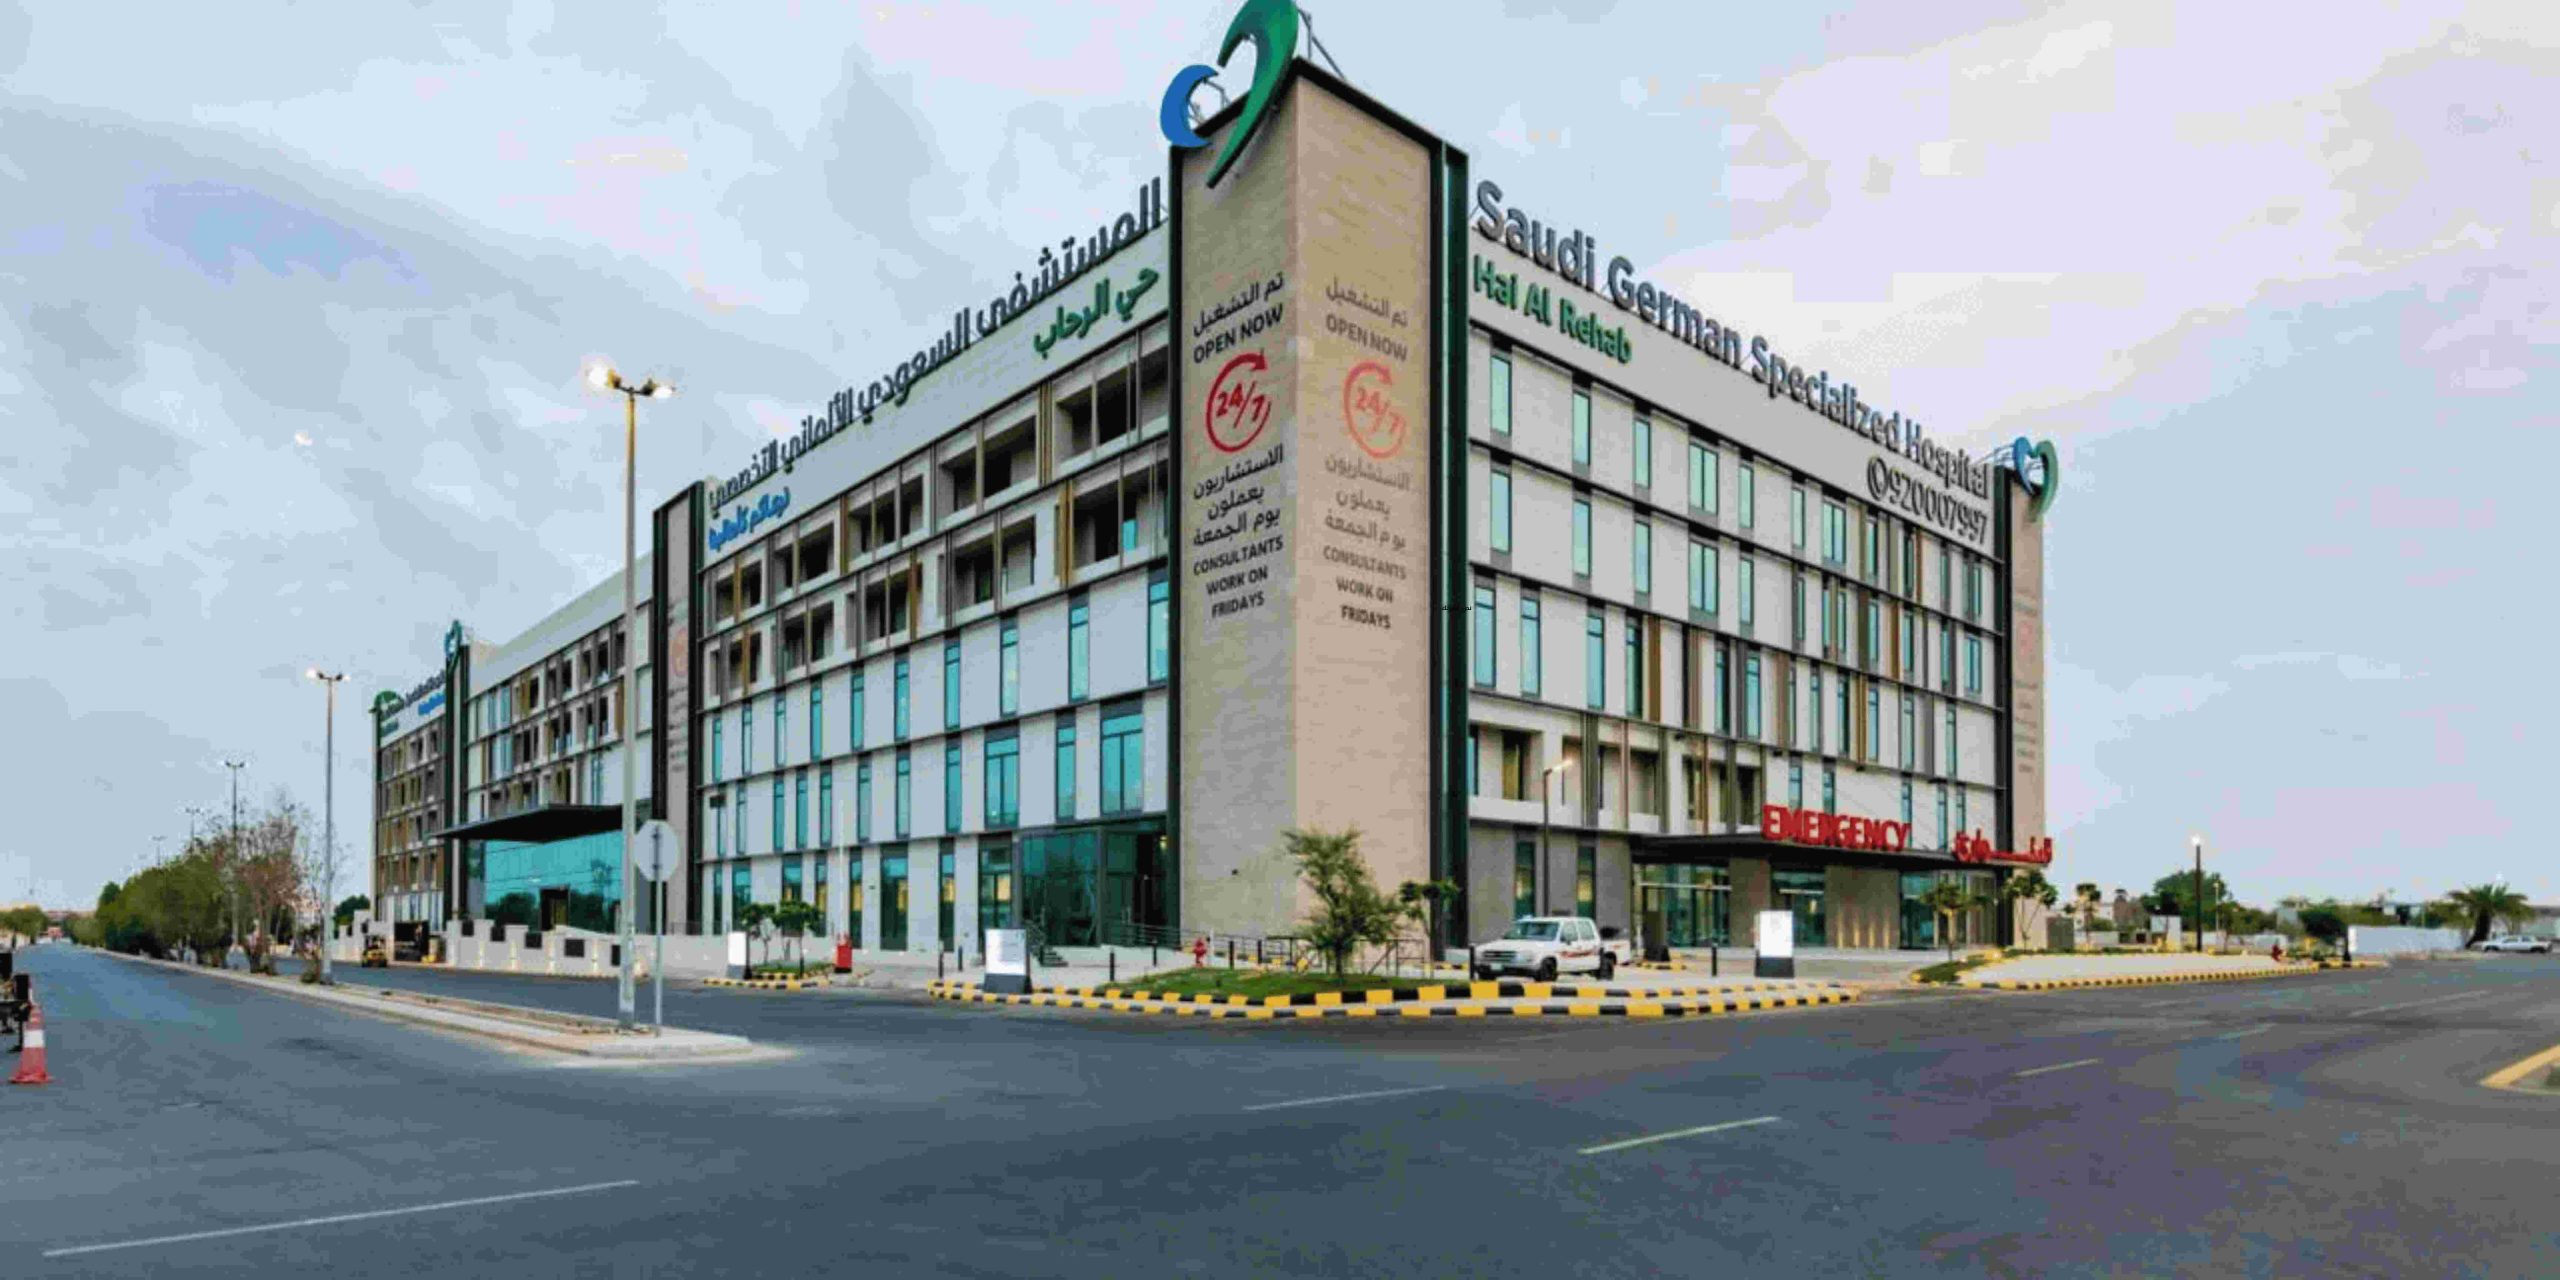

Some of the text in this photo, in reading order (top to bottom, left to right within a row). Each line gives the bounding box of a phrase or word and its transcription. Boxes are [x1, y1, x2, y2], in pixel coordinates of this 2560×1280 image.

[1033, 267, 1159, 359] حي الرحاب
[1193, 271, 1284, 337] تم التشغيل
[1523, 281, 1552, 327] Al
[1560, 297, 1632, 364] Rehab
[1193, 302, 1284, 374] OPEN NOW
[1326, 313, 1408, 362] OPEN NOW
[1476, 180, 1988, 500] Saudi German Specialized Hospital
[858, 307, 970, 424] السعودي
[1215, 380, 1266, 429] 24/7
[1356, 386, 1403, 434] 24/7
[1193, 443, 1284, 500] الاستشاريون
[1193, 508, 1281, 546] يوم الجمعة
[1207, 486, 1264, 521] يعملون
[1889, 466, 1987, 544] 920007997
[1193, 535, 1284, 576] CONSULTANTS
[1323, 545, 1406, 580] CONSULTANTS
[1206, 565, 1269, 596] WORK ON
[1211, 591, 1265, 618] FRIDAYS
[1336, 575, 1393, 603] WORK ON
[1340, 604, 1392, 630] FRIDAYS
[1763, 804, 1911, 852] EMERGENCY
